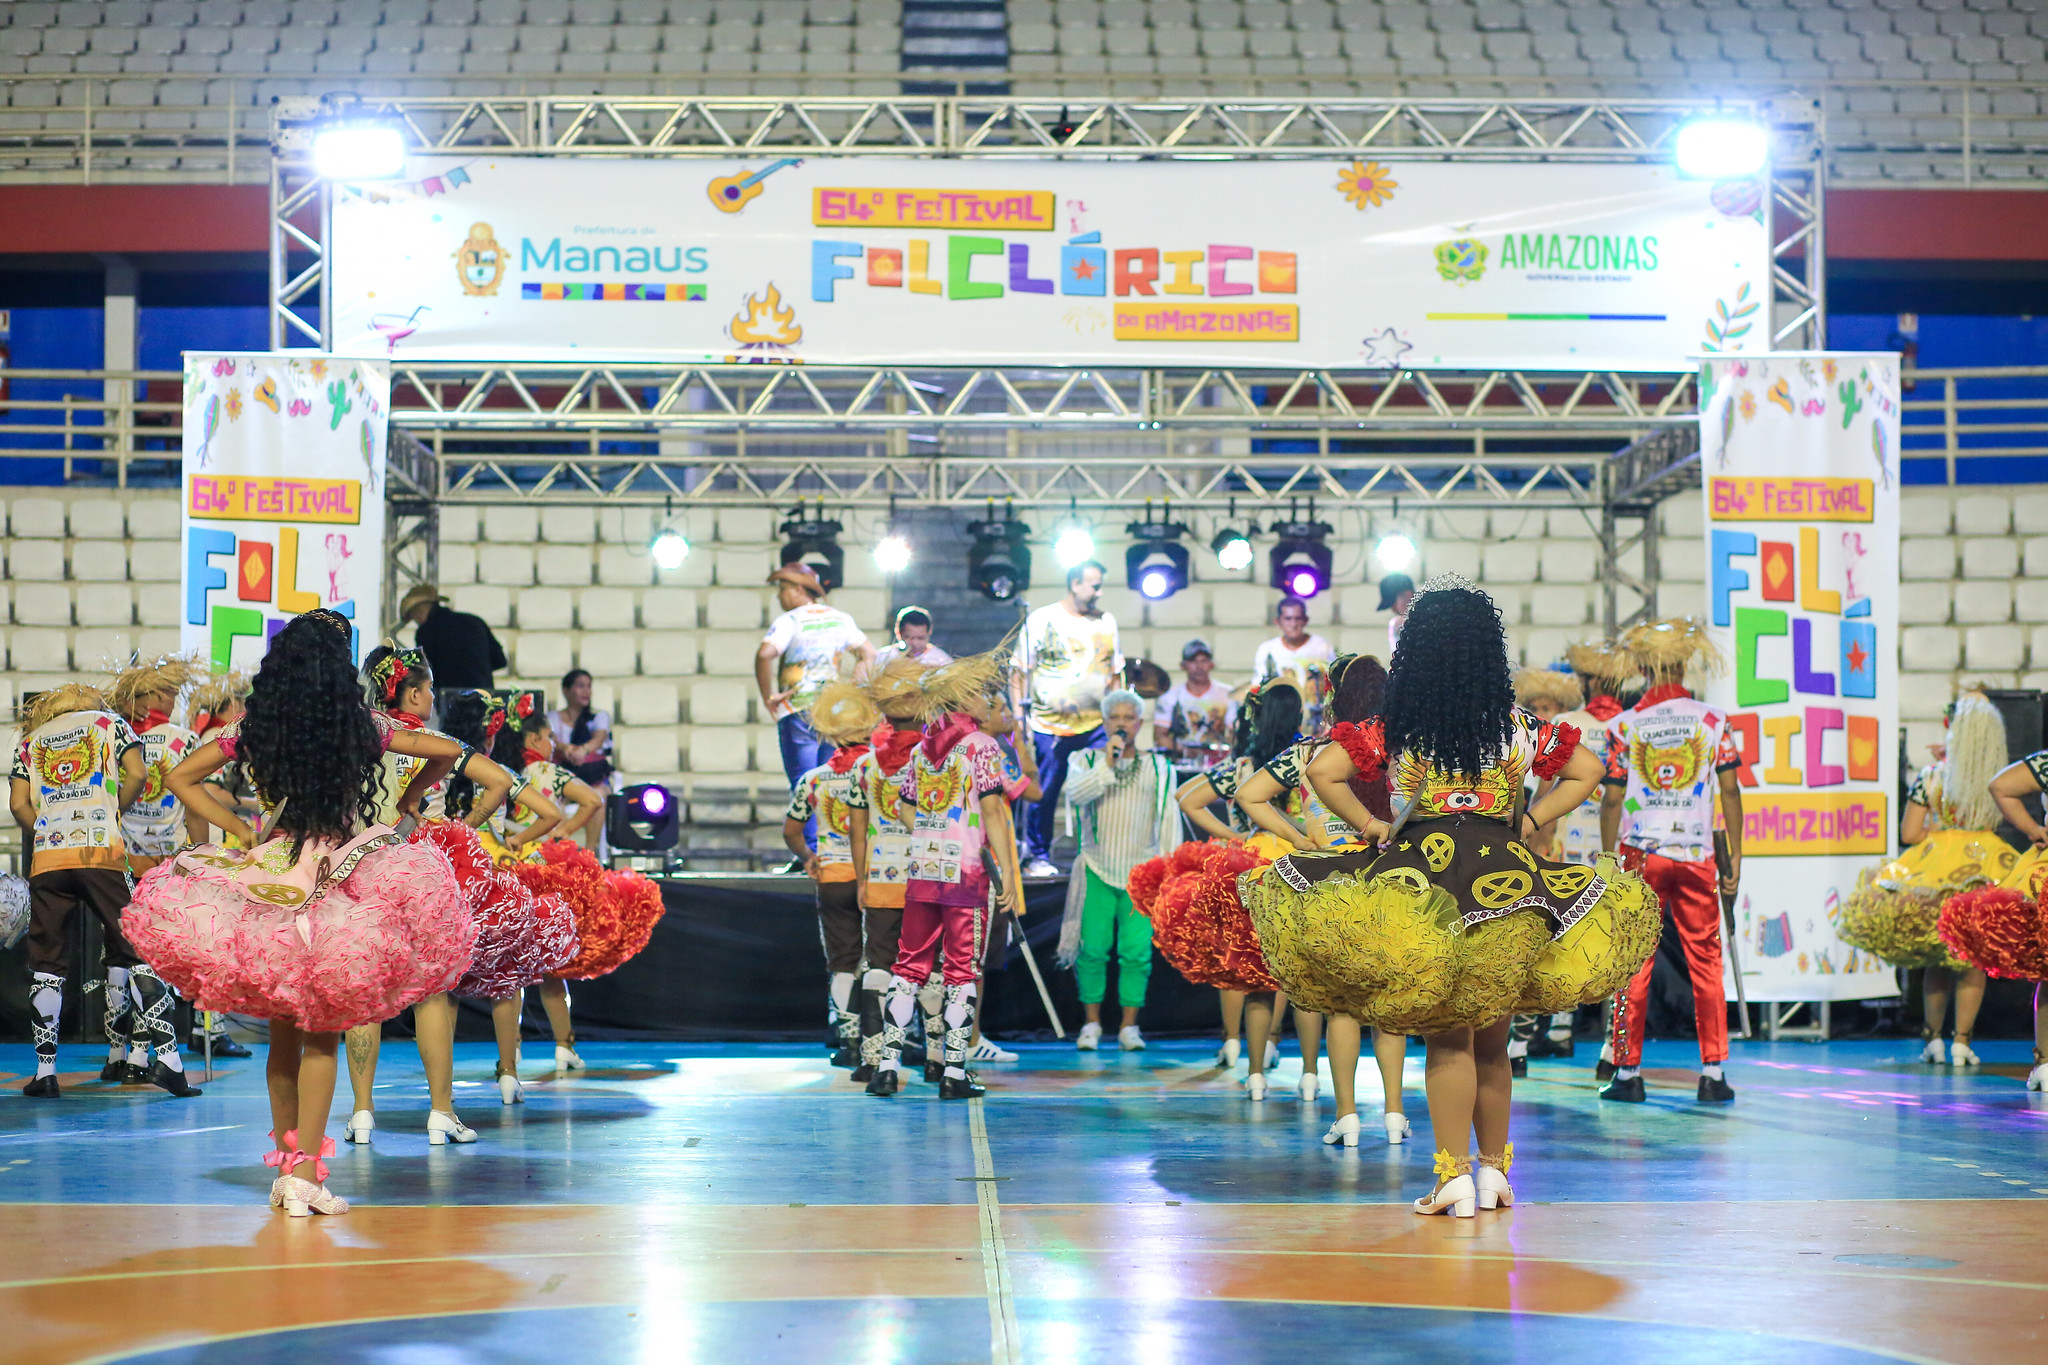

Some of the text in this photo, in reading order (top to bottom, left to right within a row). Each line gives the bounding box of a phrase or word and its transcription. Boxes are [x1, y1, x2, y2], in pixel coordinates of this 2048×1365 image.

[896, 193, 1044, 222] FESTIVAL
[574, 225, 656, 235] Prefeitura de
[521, 238, 708, 273] Manaus
[812, 231, 1298, 302] FOLCLÓRICO
[1500, 234, 1658, 271] AMAZONAS
[1145, 310, 1291, 333] AMAZONAS
[244, 482, 352, 515] FESTIVAL
[1763, 482, 1867, 513] FESTIVAL
[187, 526, 320, 625] FOL
[1711, 527, 1841, 626] FOL
[1735, 597, 1876, 708] CLÓ
[43, 728, 85, 746] QUADRILHA
[1642, 727, 1691, 740] QUADRILHA
[1722, 706, 1879, 788] RICO
[1744, 804, 1879, 842] AMAZONAS
